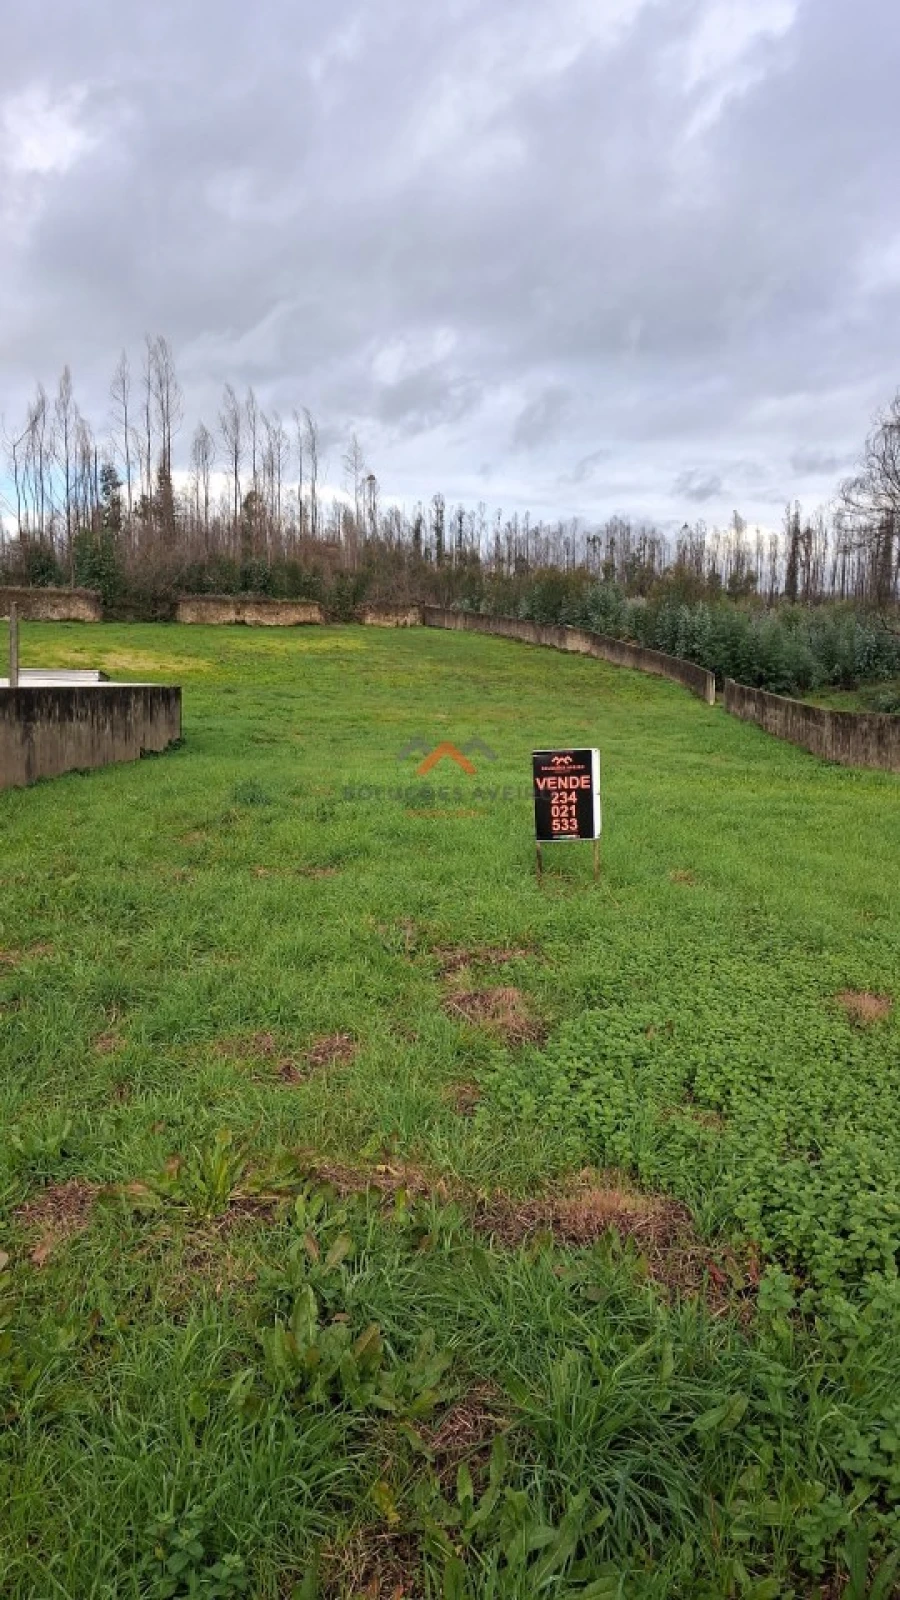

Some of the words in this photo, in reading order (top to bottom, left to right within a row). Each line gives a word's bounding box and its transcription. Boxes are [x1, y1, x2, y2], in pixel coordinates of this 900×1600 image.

[536, 775, 591, 790] VENDE
[551, 791, 577, 804] 234
[551, 805, 576, 817] 021
[552, 818, 578, 831] 533
